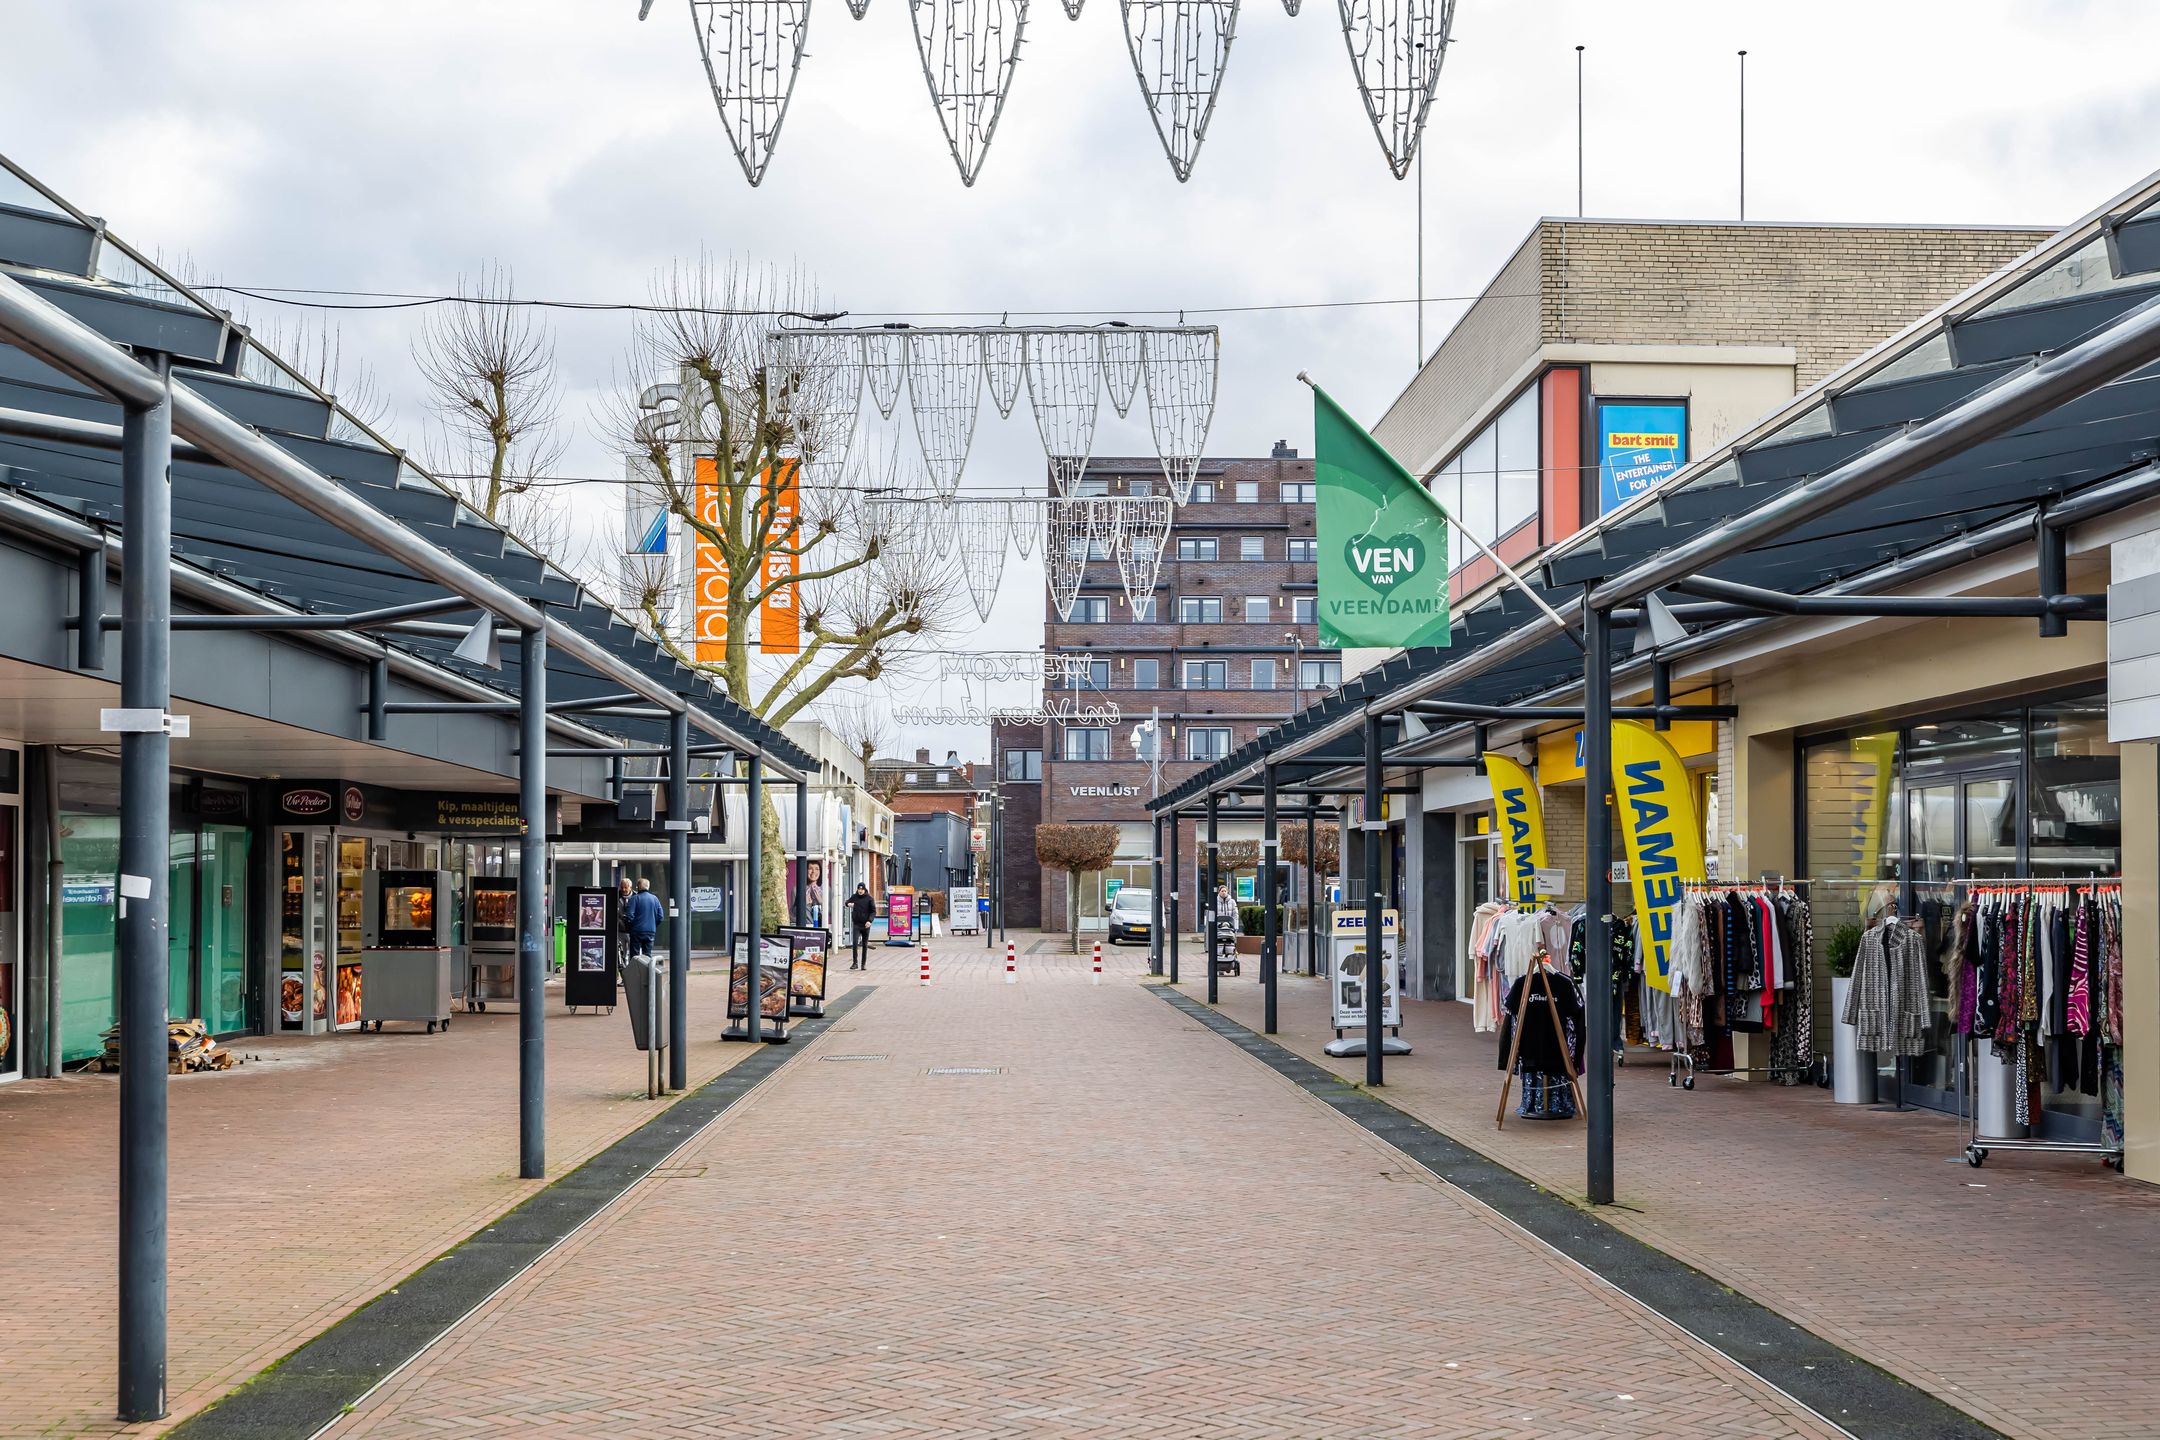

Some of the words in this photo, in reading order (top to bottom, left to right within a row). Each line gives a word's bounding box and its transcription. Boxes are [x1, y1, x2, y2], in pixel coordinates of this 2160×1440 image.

[1612, 434, 1642, 446] bart
[1644, 435, 1675, 446] smit
[1632, 453, 1651, 465] THE
[1615, 461, 1674, 482] ENTERTAINER
[1629, 479, 1649, 491] FOR
[1350, 547, 1415, 574] VEN
[1371, 575, 1394, 585] VAN
[1330, 598, 1440, 616] VEENDAM!
[1070, 786, 1140, 797] VEENLUST
[301, 794, 327, 806] Poelier
[438, 800, 459, 812] Kip,
[461, 801, 518, 814] maaltijden
[438, 814, 446, 824] &
[449, 815, 522, 827] versspecialist
[1613, 865, 1625, 880] sale
[1337, 916, 1393, 928] ZEEN
[773, 957, 788, 965] 1.49
